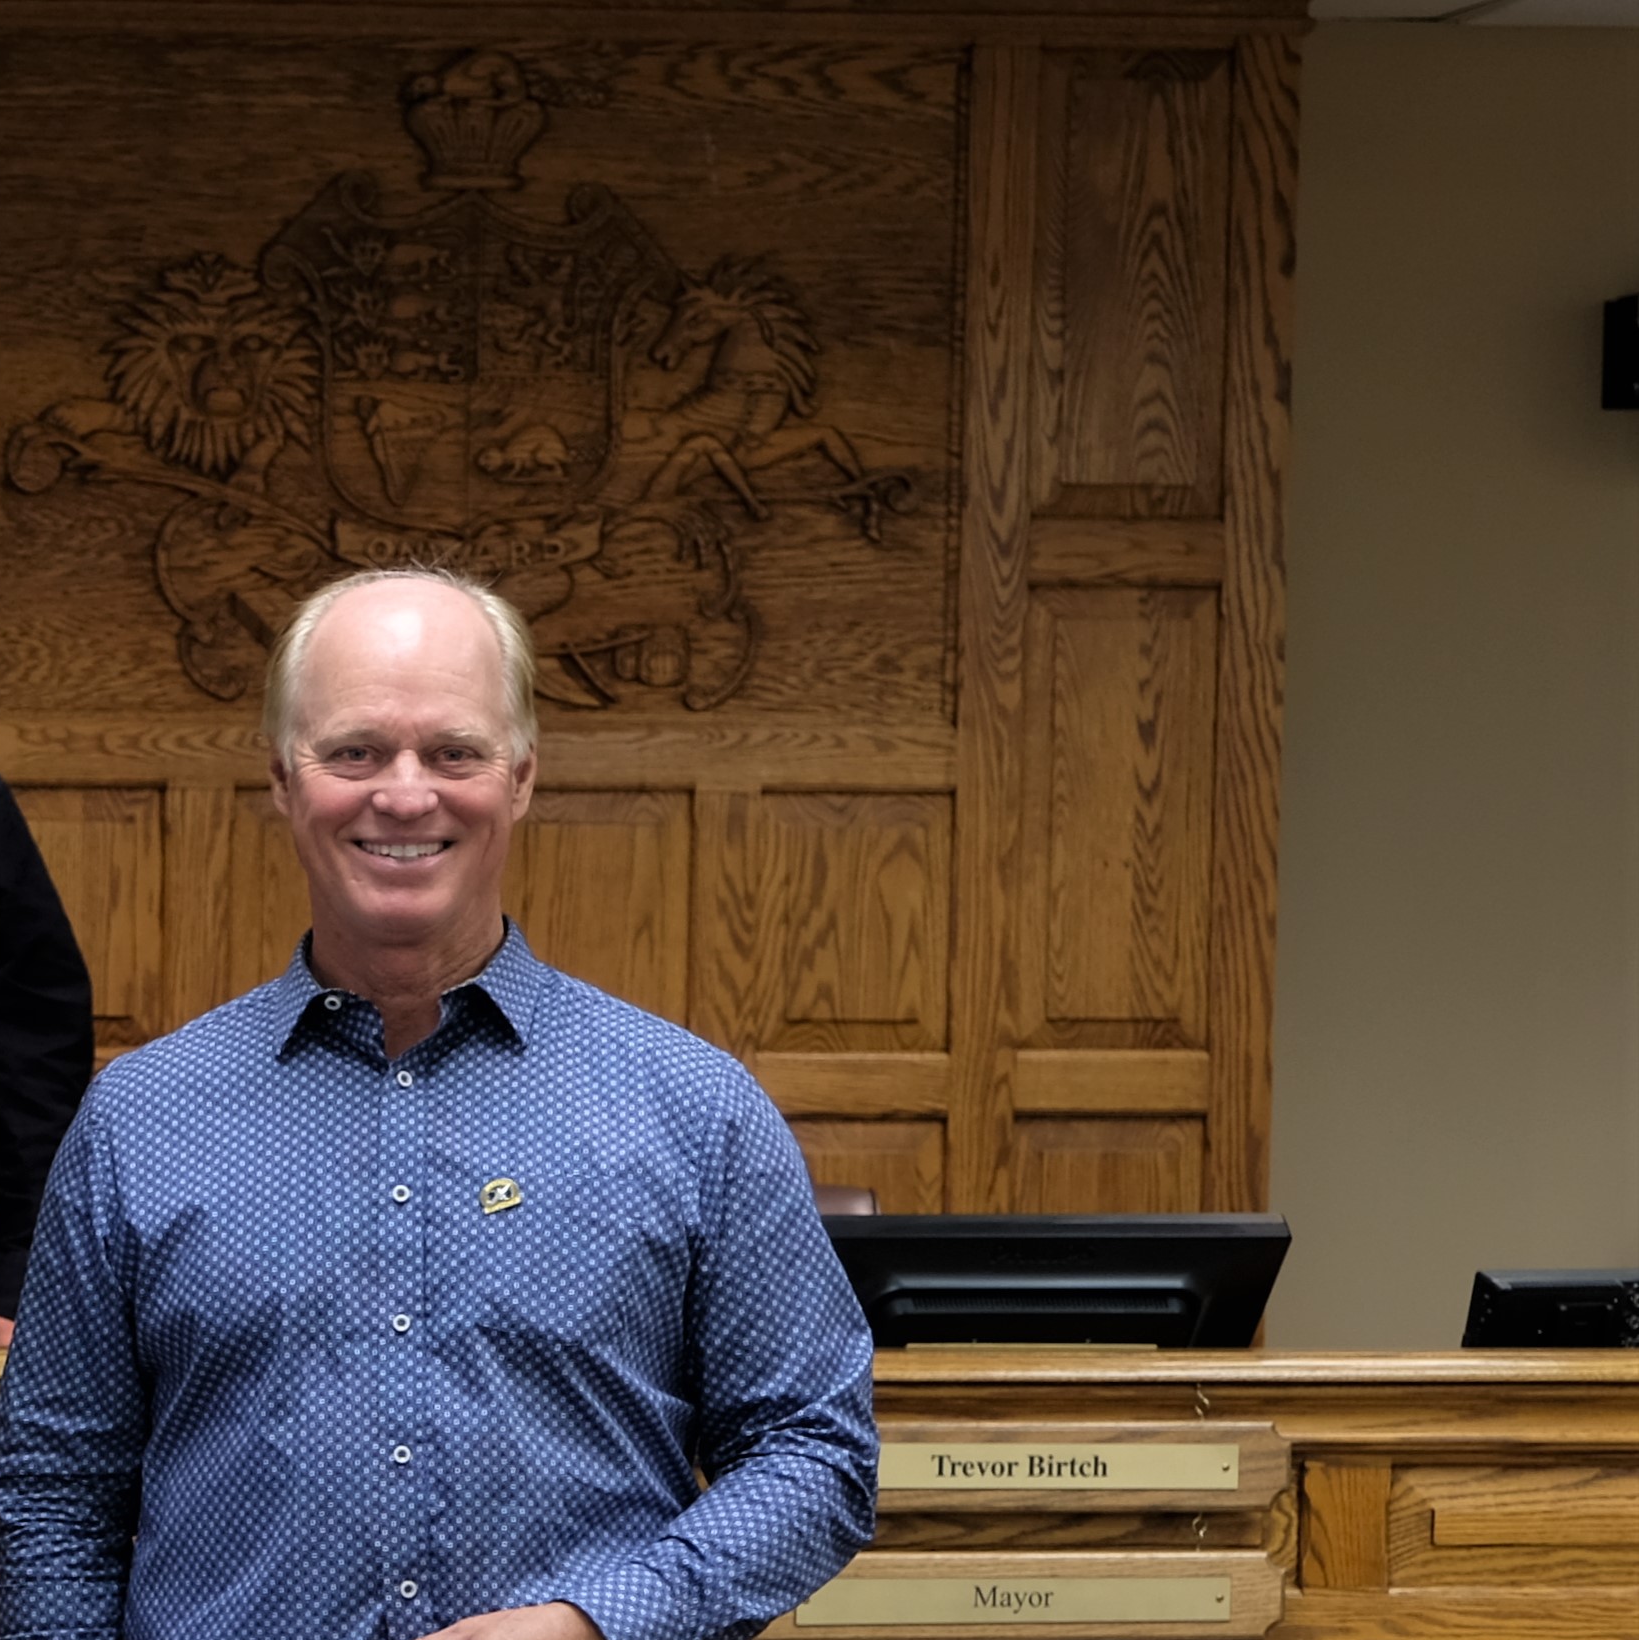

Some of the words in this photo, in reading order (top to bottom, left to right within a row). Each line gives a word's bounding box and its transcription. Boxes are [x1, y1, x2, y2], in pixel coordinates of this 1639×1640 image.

[931, 1455, 1020, 1478] Trevor
[1027, 1454, 1109, 1478] Birtch
[973, 1586, 1055, 1614] Mayor
